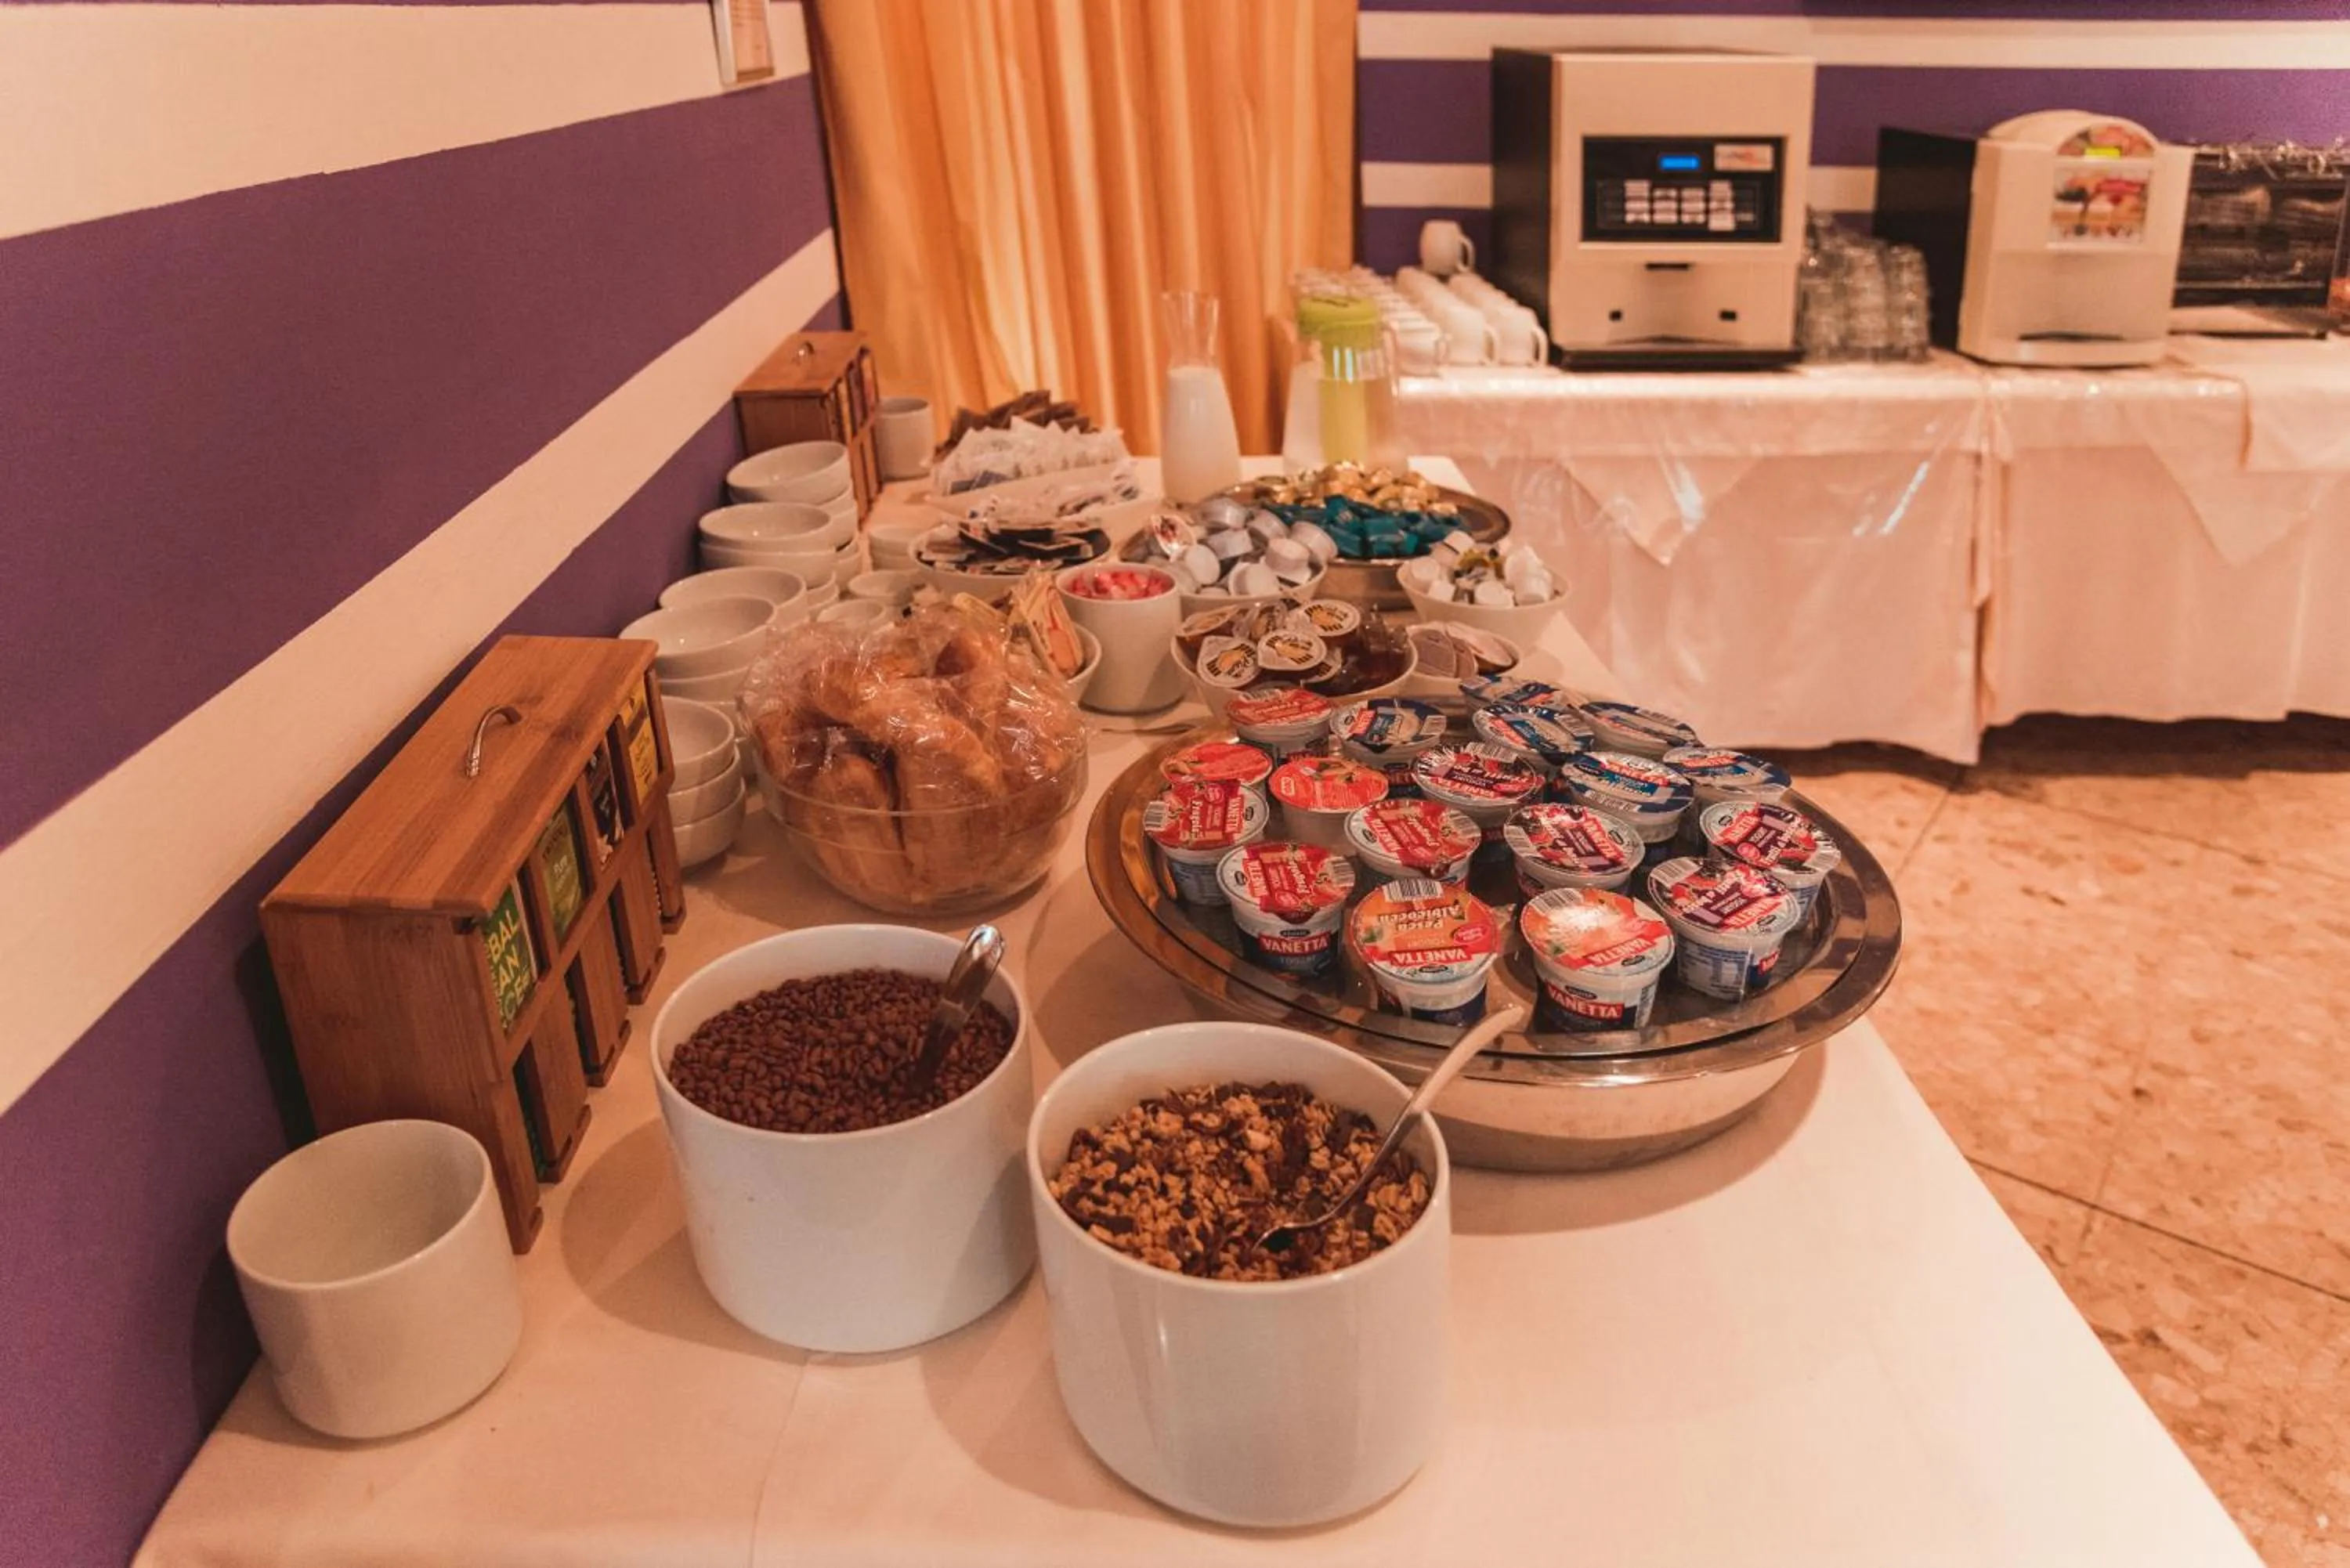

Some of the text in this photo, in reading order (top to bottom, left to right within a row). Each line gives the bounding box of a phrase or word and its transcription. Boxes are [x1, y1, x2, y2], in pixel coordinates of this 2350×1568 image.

[1399, 919, 1443, 931] Pesca
[1261, 936, 1329, 953] VANETTA
[1588, 938, 1656, 963] VANETTA
[1394, 948, 1467, 964] VANETTA
[1547, 984, 1618, 1018] VANETTA
